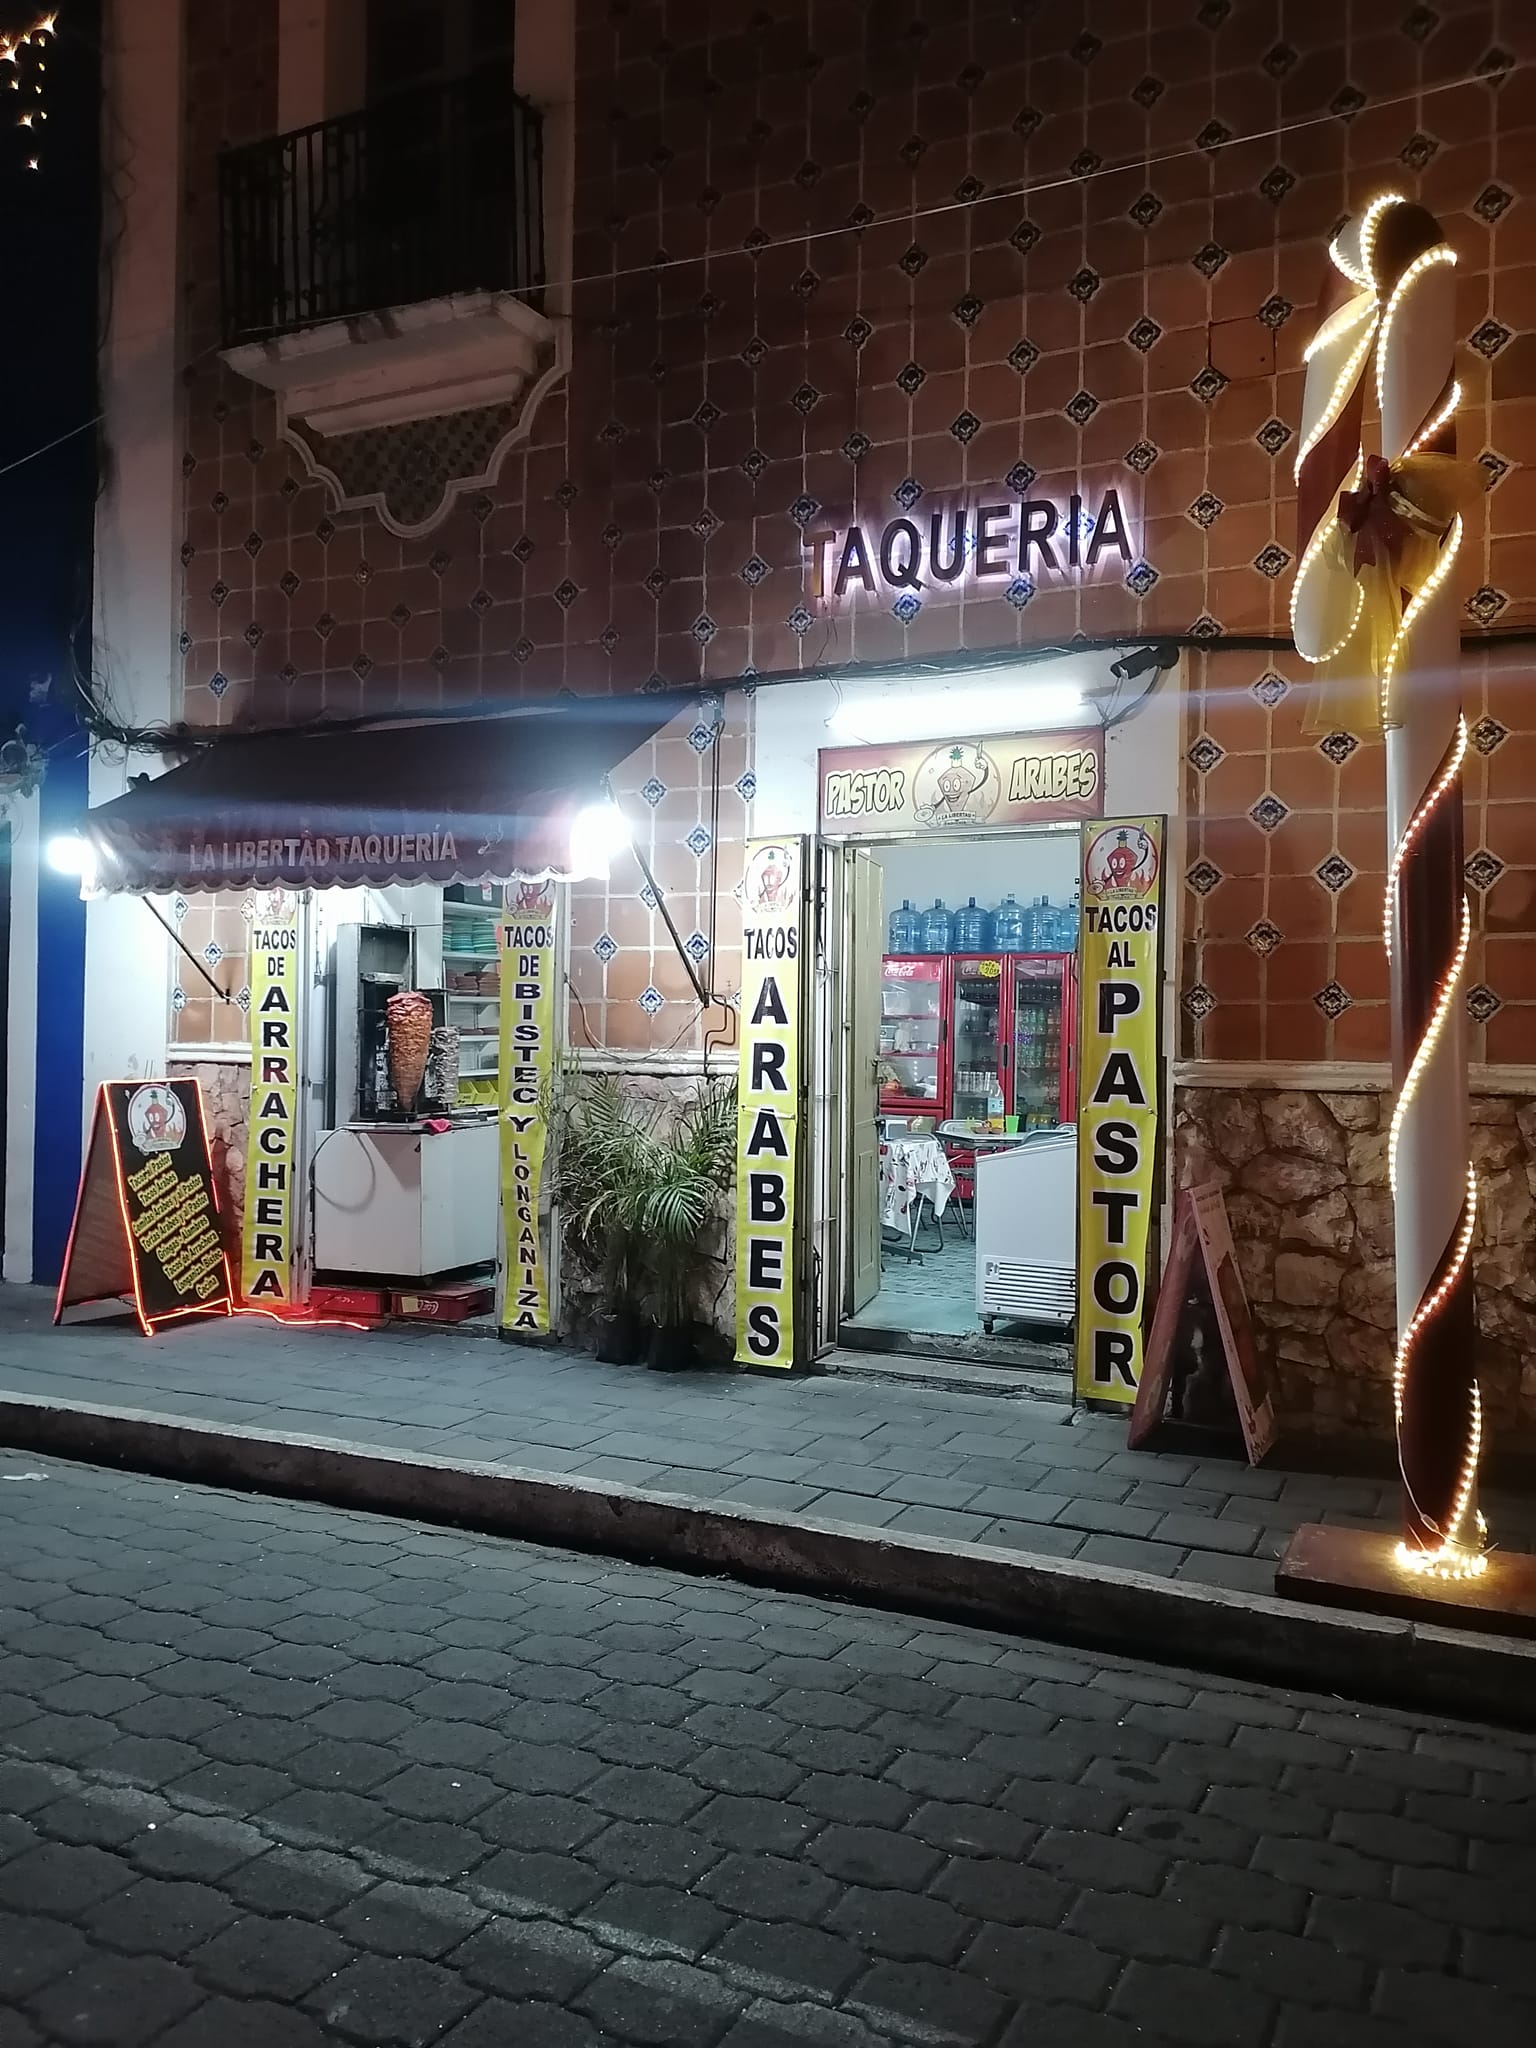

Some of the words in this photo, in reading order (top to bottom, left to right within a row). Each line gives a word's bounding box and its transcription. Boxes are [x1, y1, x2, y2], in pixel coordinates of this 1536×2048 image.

[803, 489, 1132, 598] TAQUERIA
[826, 770, 905, 816] PASTOR
[1008, 752, 1097, 801] ARABES
[189, 843, 215, 871] LA
[222, 836, 330, 870] LIBERTAD
[1085, 904, 1157, 932] TACOS
[254, 929, 296, 950] TACOS
[505, 926, 554, 948] TACOS
[744, 926, 797, 959] TACOS
[1107, 941, 1136, 967] AL
[267, 957, 285, 976] DE
[519, 955, 539, 976] DE
[512, 983, 541, 1104] BISTEC
[509, 1116, 536, 1132] Y
[250, 986, 290, 1298] ARRACHERA
[128, 1170, 147, 1189] Tacos
[151, 1154, 171, 1171] Pastor
[747, 976, 789, 1357] ARABES
[139, 1186, 158, 1204] Tacos
[156, 1172, 177, 1190] Arabes
[153, 1197, 174, 1216] Arabes
[182, 1175, 202, 1193] Pastor
[1093, 982, 1145, 1388] PASTOR
[141, 1231, 161, 1251] Tortas
[159, 1215, 180, 1235] Arabes
[188, 1193, 208, 1211] Pastor
[157, 1239, 180, 1260] Gringas
[181, 1216, 208, 1239] Alambres
[513, 1143, 539, 1329] LONGANIZA
[163, 1261, 182, 1278] Tacos
[189, 1232, 218, 1255] Arrachera
[203, 1250, 223, 1268] Bistec
[197, 1277, 218, 1297] Cecina
